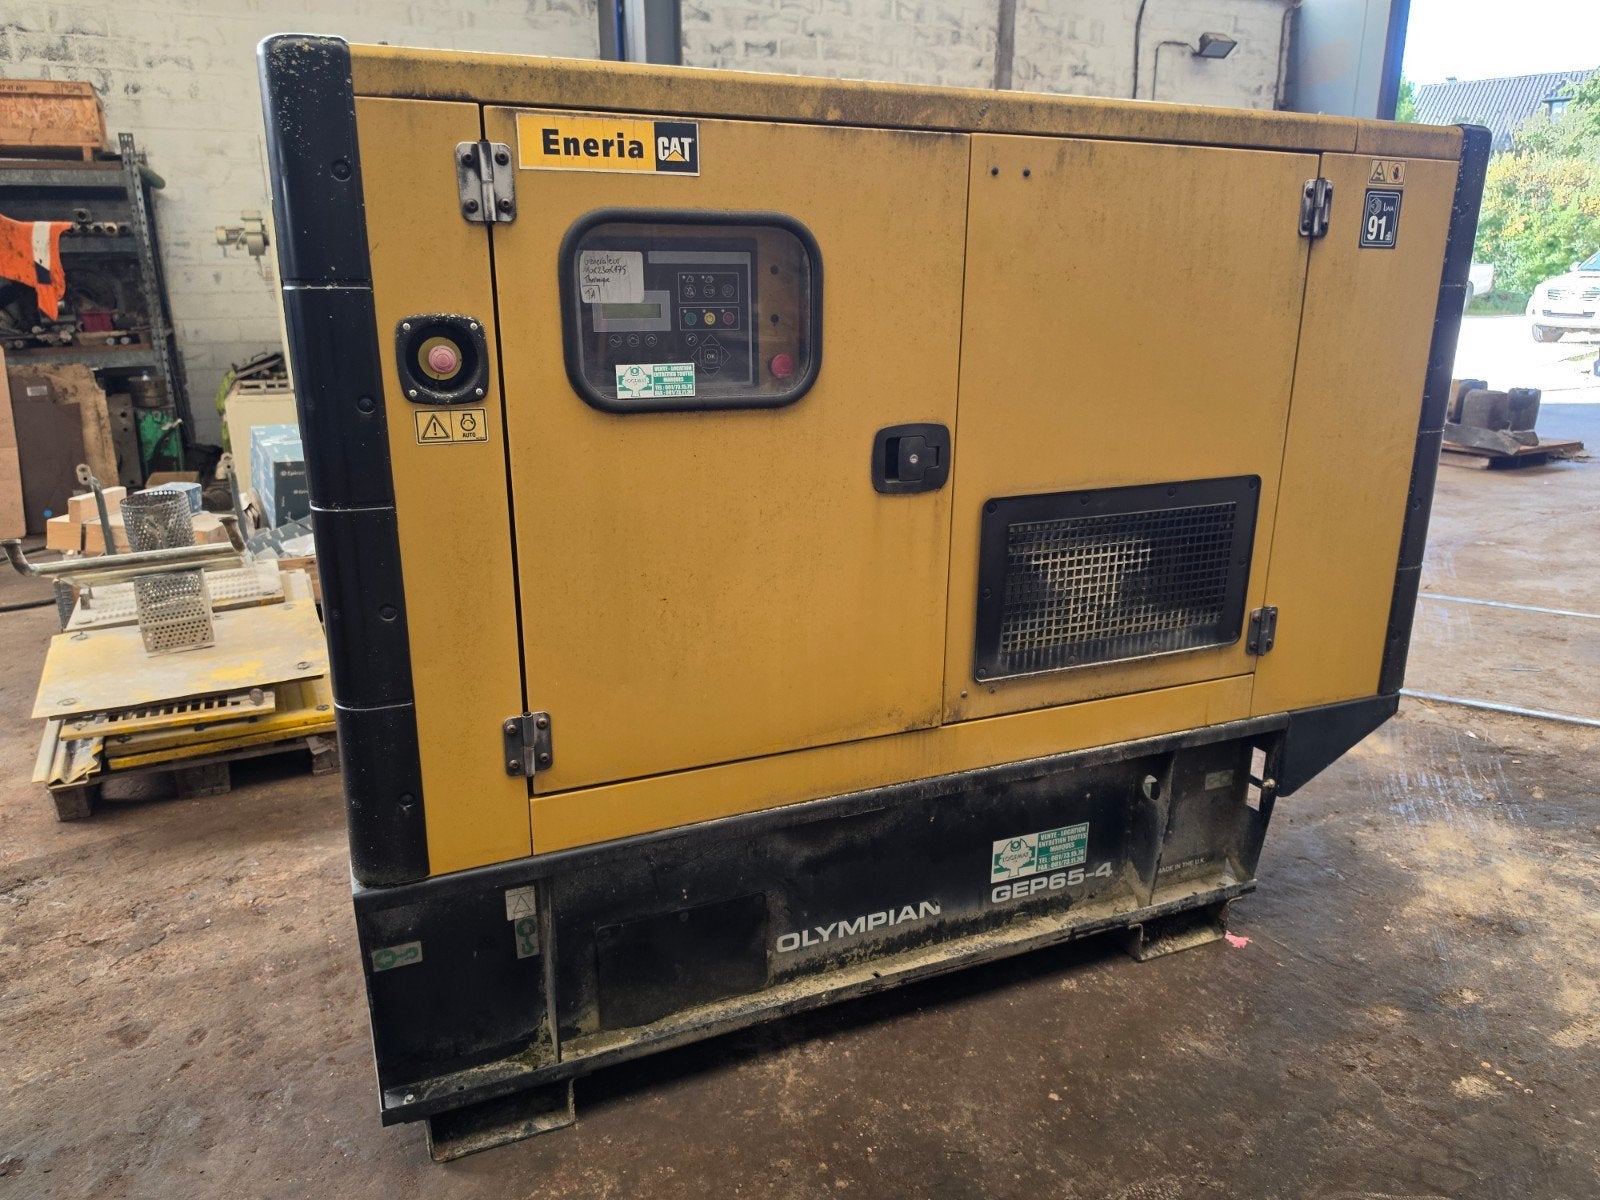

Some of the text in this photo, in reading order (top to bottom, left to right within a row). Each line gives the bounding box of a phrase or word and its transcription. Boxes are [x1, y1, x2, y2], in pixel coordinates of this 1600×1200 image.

[542, 128, 692, 162] Eneria CAT
[1366, 215, 1387, 241] 91
[1040, 832, 1058, 841] VENTE
[1060, 825, 1086, 836] LOCATION
[991, 861, 1113, 904] GEP65-4
[776, 900, 941, 953] OLYMPIAN
